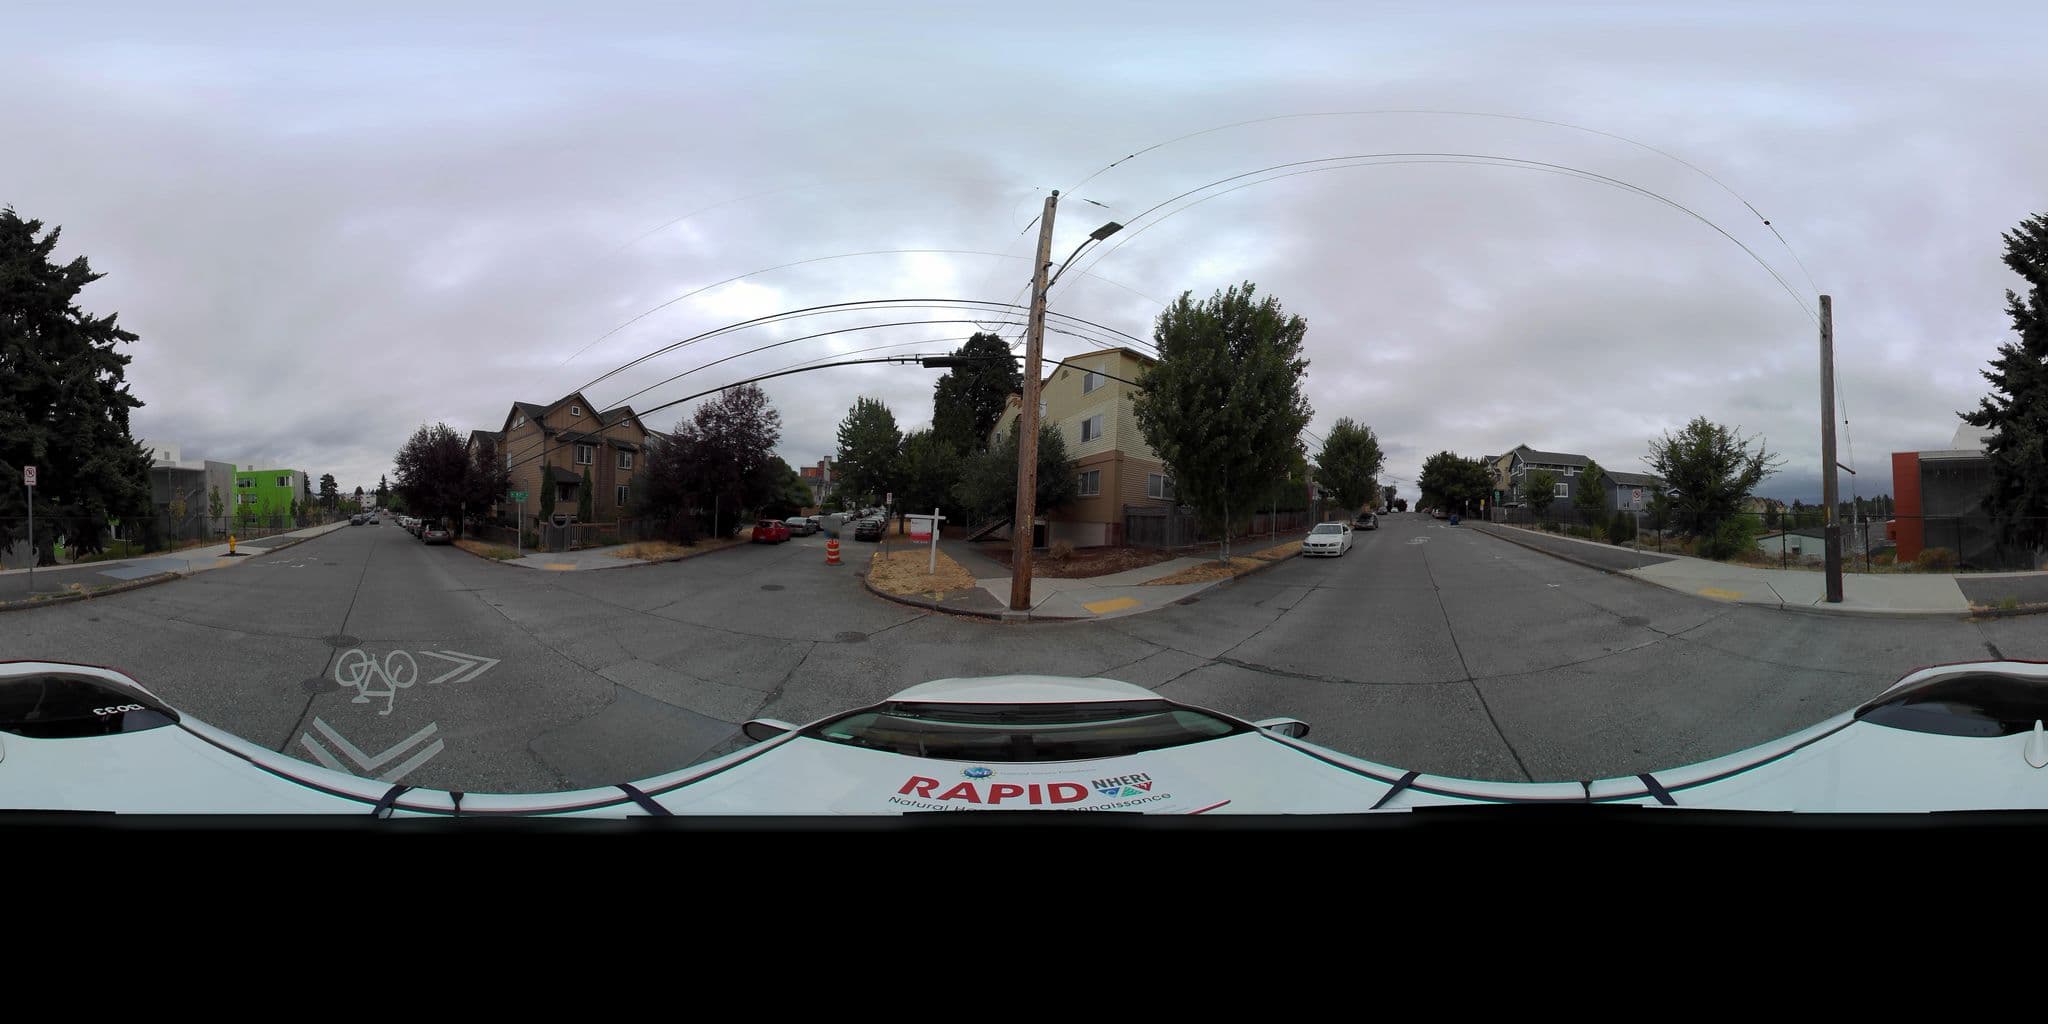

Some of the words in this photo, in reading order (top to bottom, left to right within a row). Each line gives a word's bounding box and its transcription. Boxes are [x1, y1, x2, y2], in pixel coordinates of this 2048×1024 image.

[1091, 772, 1152, 789] NHERI
[898, 775, 1089, 805] RAPID
[888, 796, 949, 812] Natural
